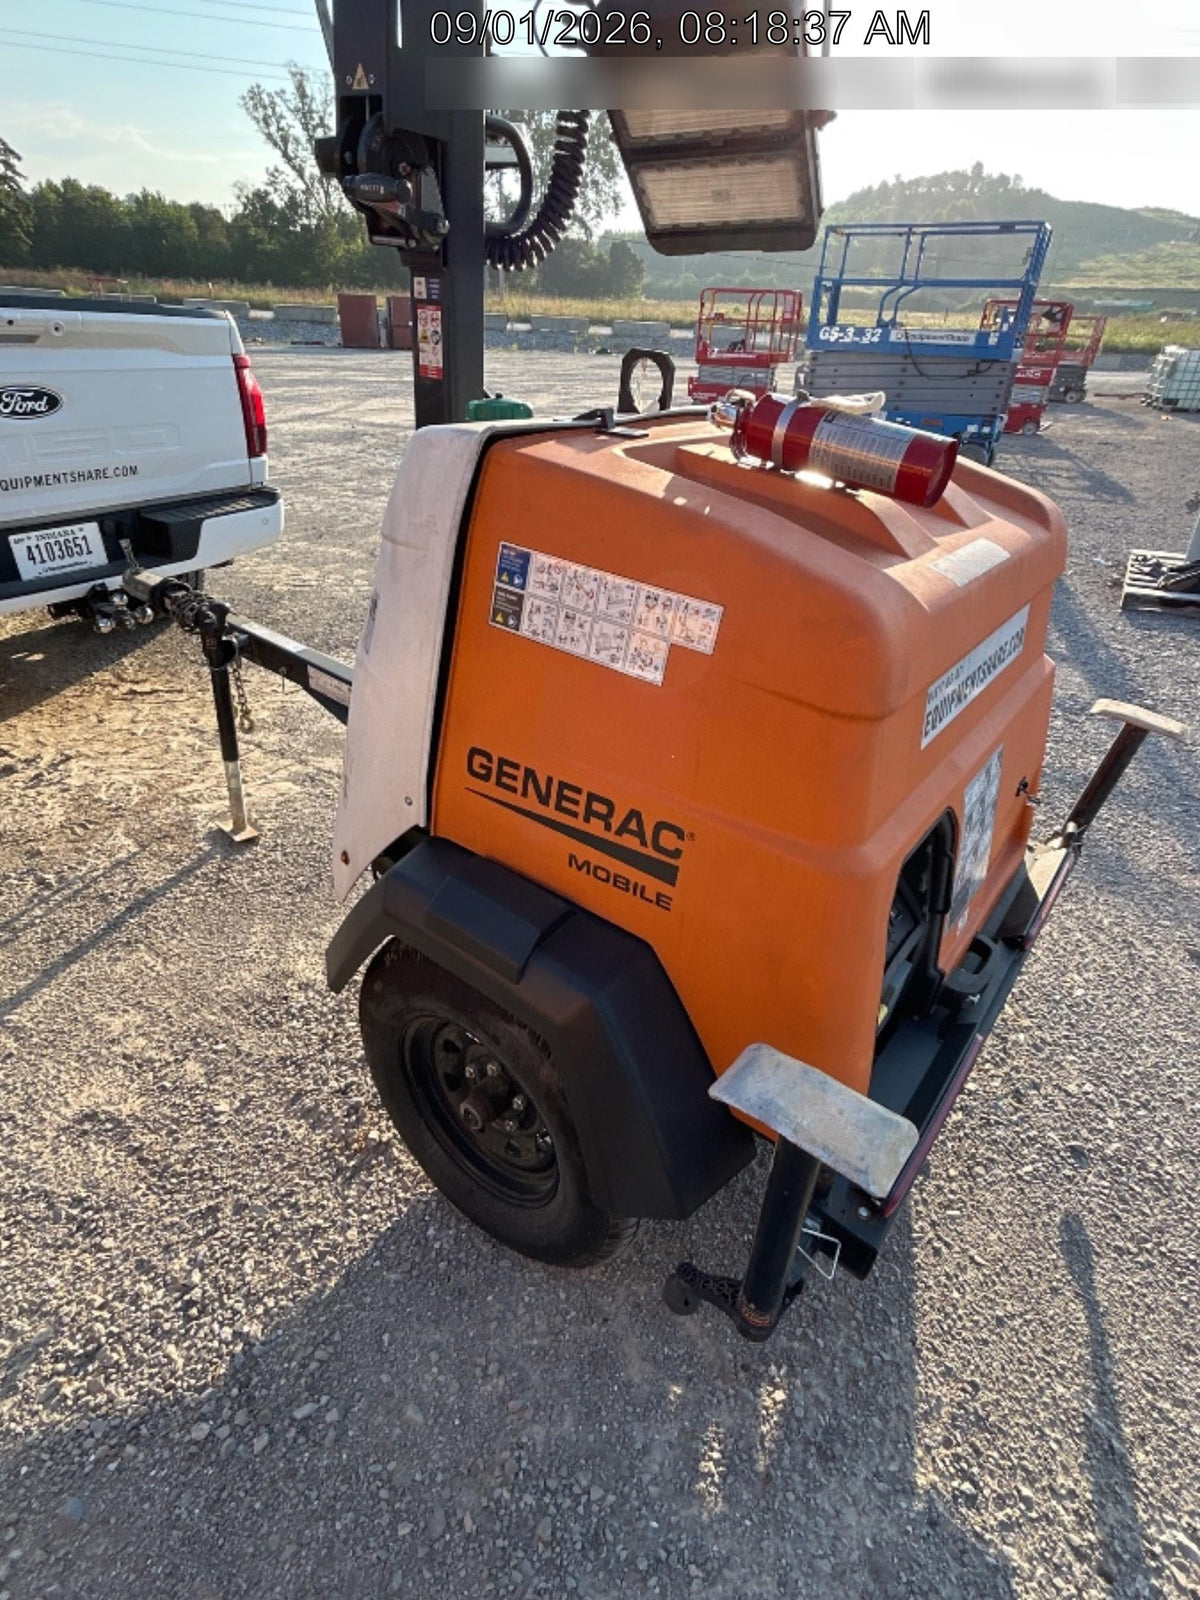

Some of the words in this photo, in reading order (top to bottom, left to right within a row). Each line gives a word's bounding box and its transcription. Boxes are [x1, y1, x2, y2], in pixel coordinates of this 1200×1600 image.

[0, 392, 49, 413] Ford
[26, 535, 93, 565] 4103651
[466, 746, 686, 861] GENERAC
[567, 853, 673, 912] MOBILE
